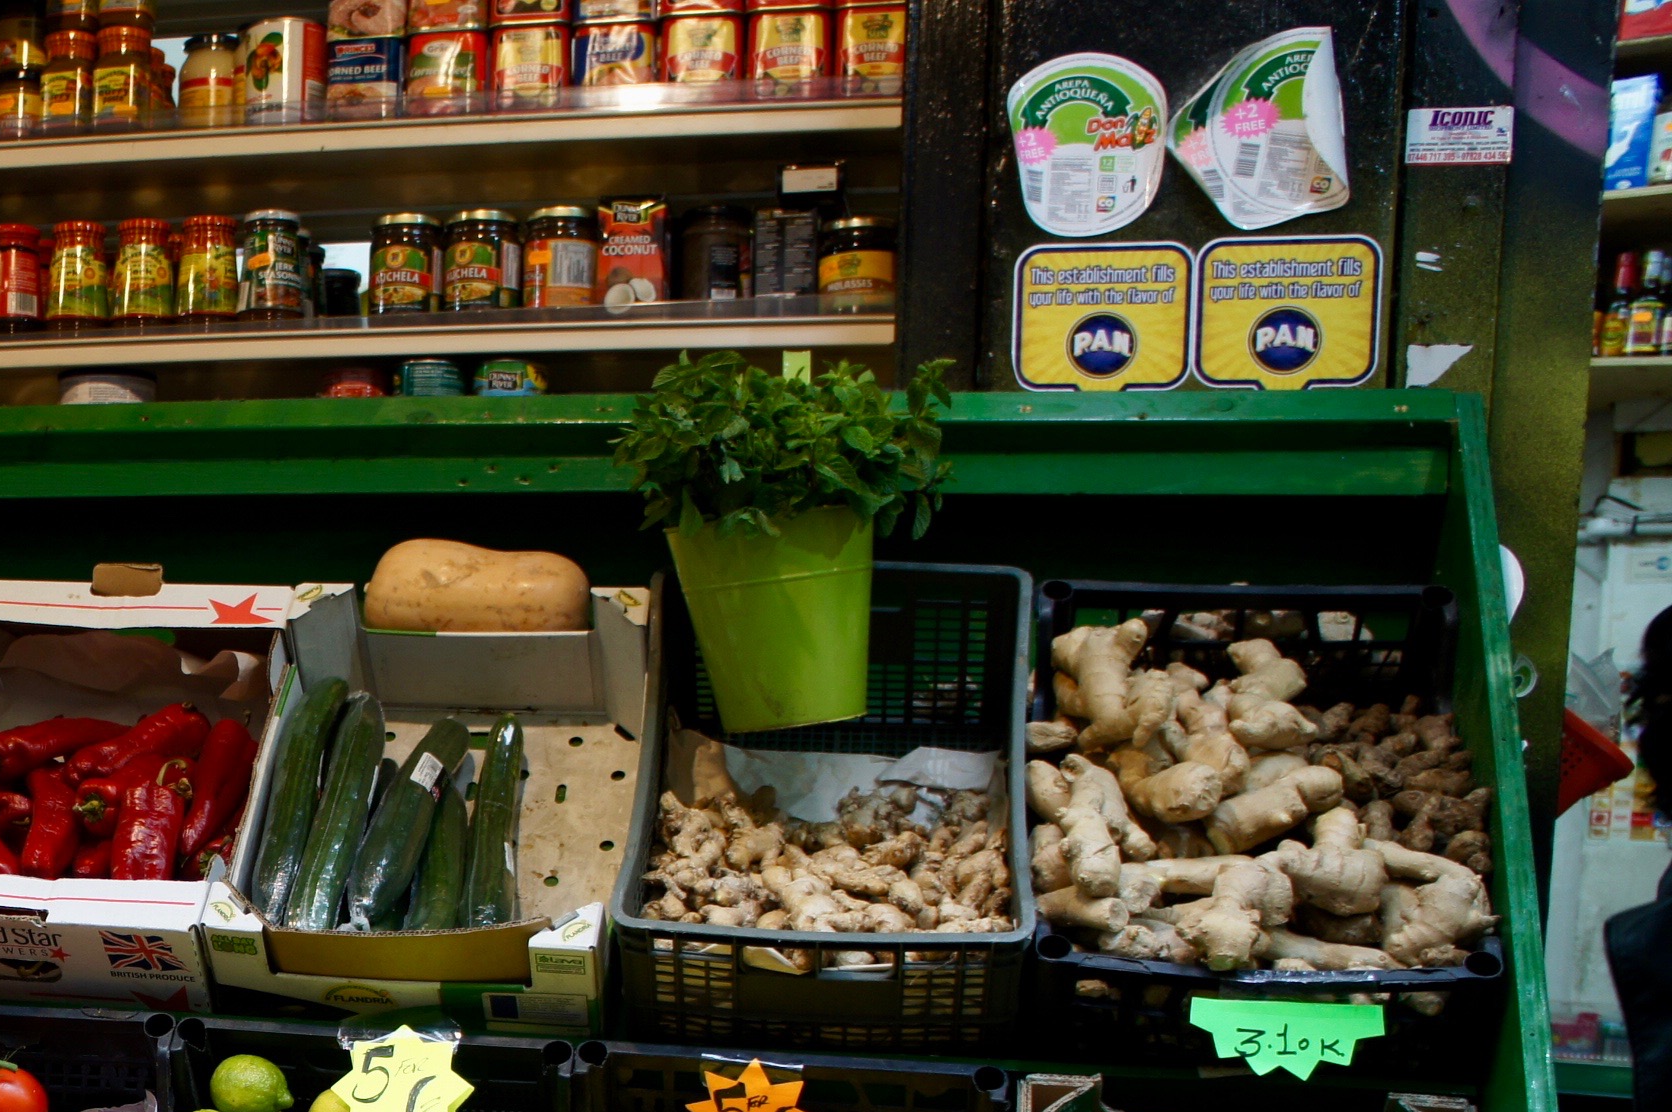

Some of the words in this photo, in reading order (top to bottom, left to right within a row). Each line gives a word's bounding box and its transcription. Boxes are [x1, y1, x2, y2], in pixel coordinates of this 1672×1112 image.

[863, 52, 887, 62] BEEF
[329, 66, 361, 76] ORNED
[363, 64, 387, 74] BEEF
[1054, 79, 1091, 92] AREPA
[1035, 87, 1115, 120] ANTIOQUEÑA
[1234, 103, 1259, 119] +2
[1086, 115, 1128, 135] Don
[1234, 120, 1266, 133] FREE
[1429, 109, 1495, 127] ICONIC
[1020, 147, 1046, 160] FREE
[608, 235, 651, 245] CREAMED
[602, 244, 658, 256] COCONUT
[1031, 267, 1054, 285] This
[1058, 265, 1148, 284] establishment
[1152, 265, 1175, 283] fills
[1211, 260, 1237, 279] This
[1239, 259, 1333, 278] establishment
[1337, 257, 1363, 276] fills
[1029, 291, 1053, 307] your
[1056, 289, 1073, 304] life
[1077, 288, 1101, 304] with
[1104, 288, 1124, 304] the
[1128, 288, 1158, 304] flavor
[1162, 287, 1175, 303] of
[1210, 285, 1236, 302] your
[1238, 282, 1256, 299] life
[1259, 281, 1285, 299] with
[1288, 281, 1309, 298] the
[1311, 280, 1345, 298] flavor
[1348, 280, 1362, 297] of
[13, 927, 63, 947] Star
[109, 970, 146, 981] BRITISH
[147, 972, 197, 983] PRODUCE
[333, 994, 392, 1005] FLANDRIA
[1234, 1023, 1311, 1058] 3.10
[351, 1044, 395, 1104] 5
